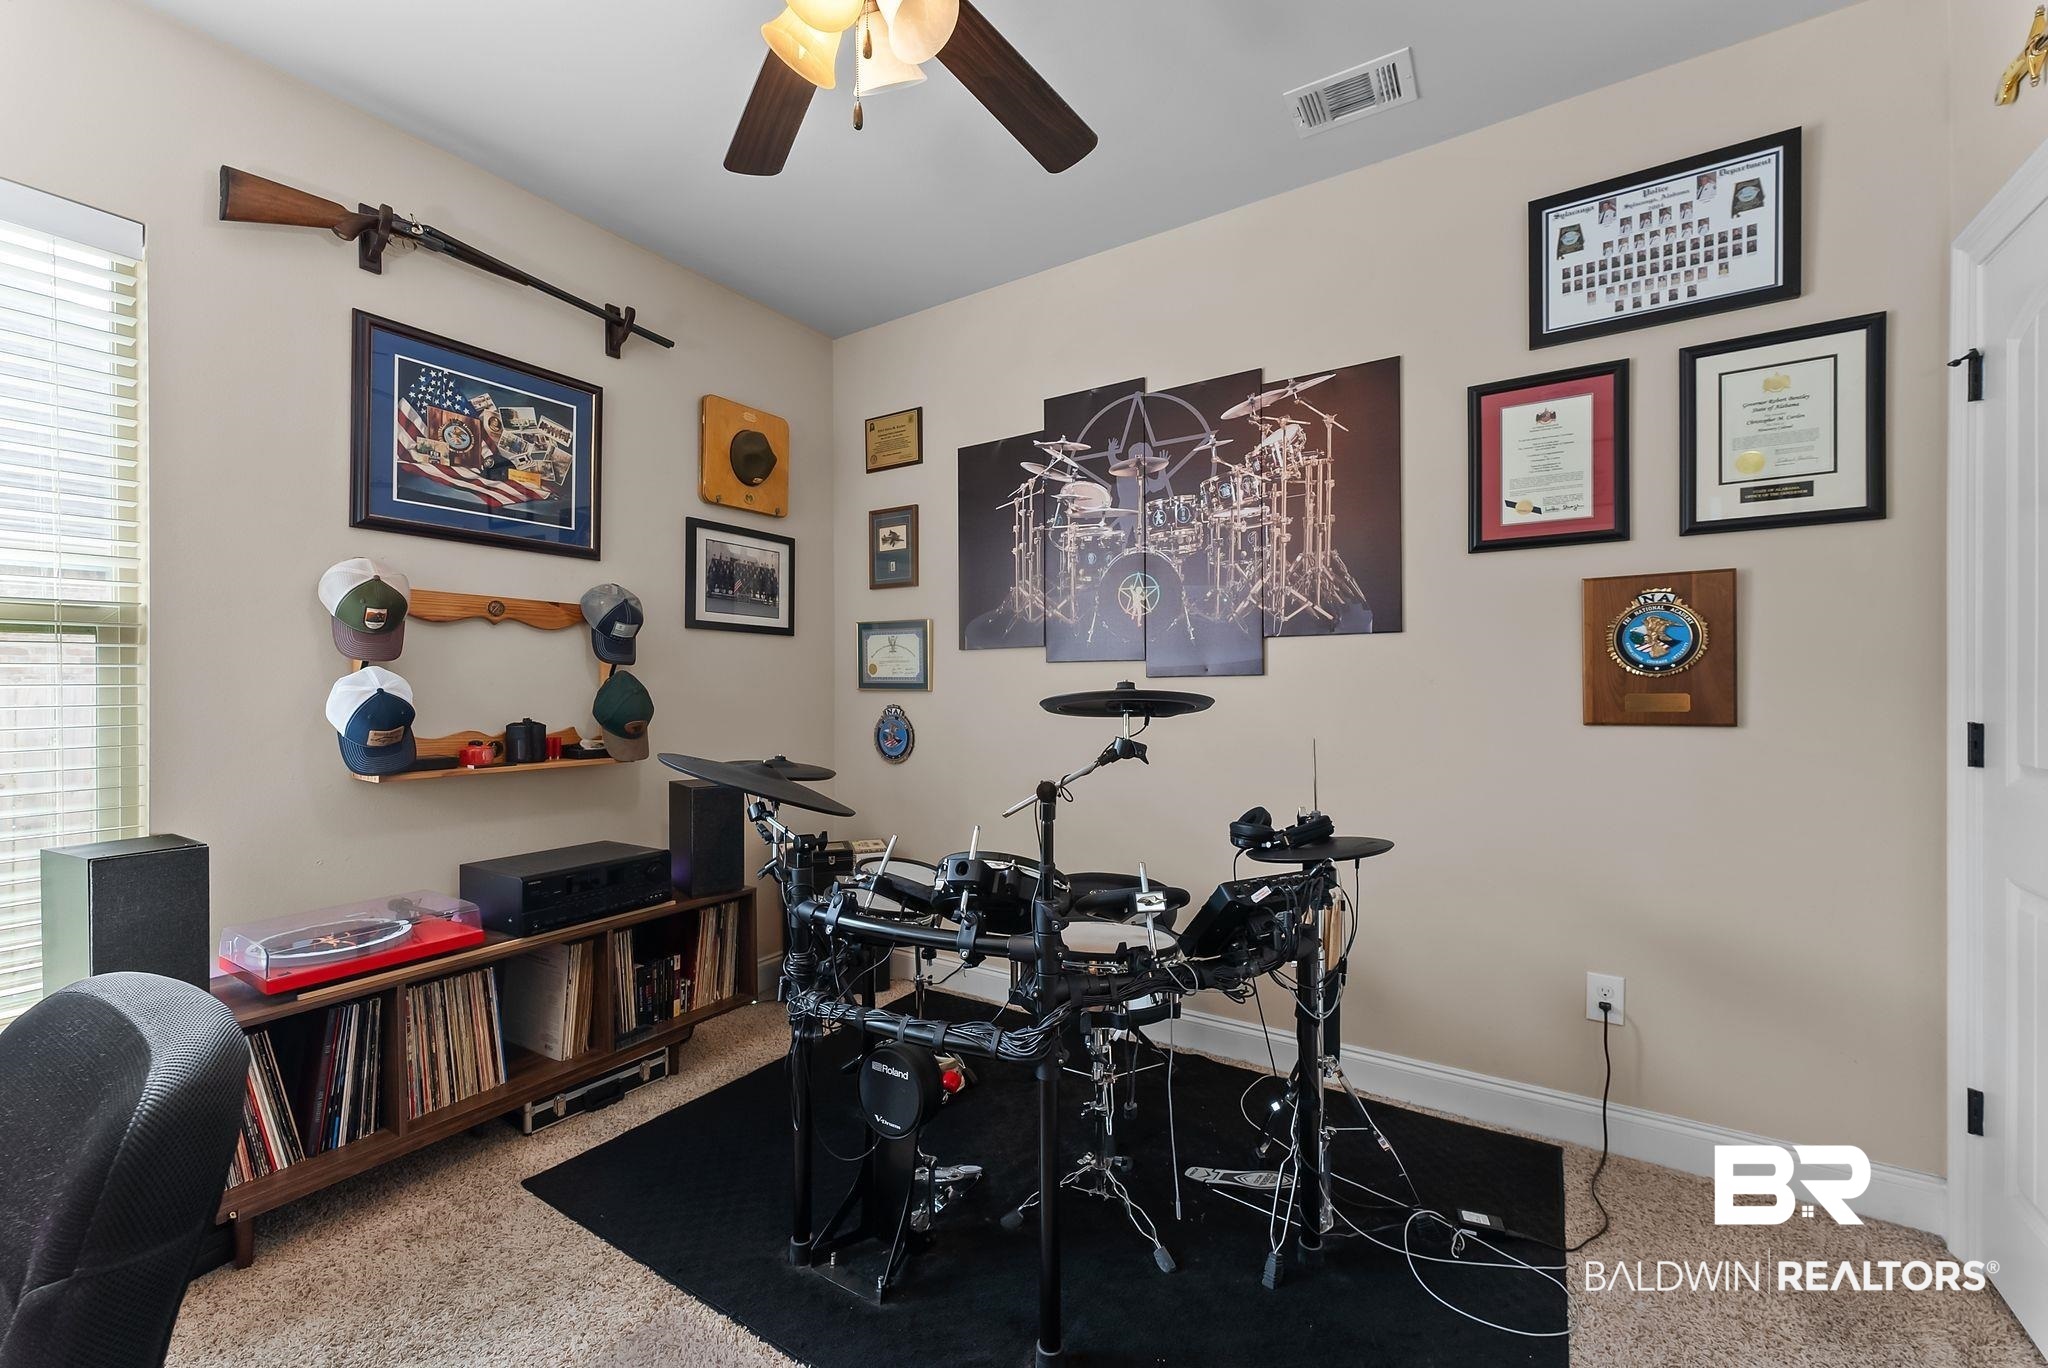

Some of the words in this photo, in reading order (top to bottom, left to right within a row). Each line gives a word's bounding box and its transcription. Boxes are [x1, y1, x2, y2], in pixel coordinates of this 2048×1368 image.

[1718, 158, 1771, 176] Department
[1642, 185, 1669, 198] Police
[1552, 205, 1595, 220] Sylacauga
[1641, 593, 1672, 604] NA
[1622, 616, 1632, 626] FBI
[1633, 605, 1665, 616] NATIONAL
[1670, 607, 1695, 625] ACADEMY
[882, 1064, 909, 1080] Roland
[874, 1113, 901, 1130] V-Drums
